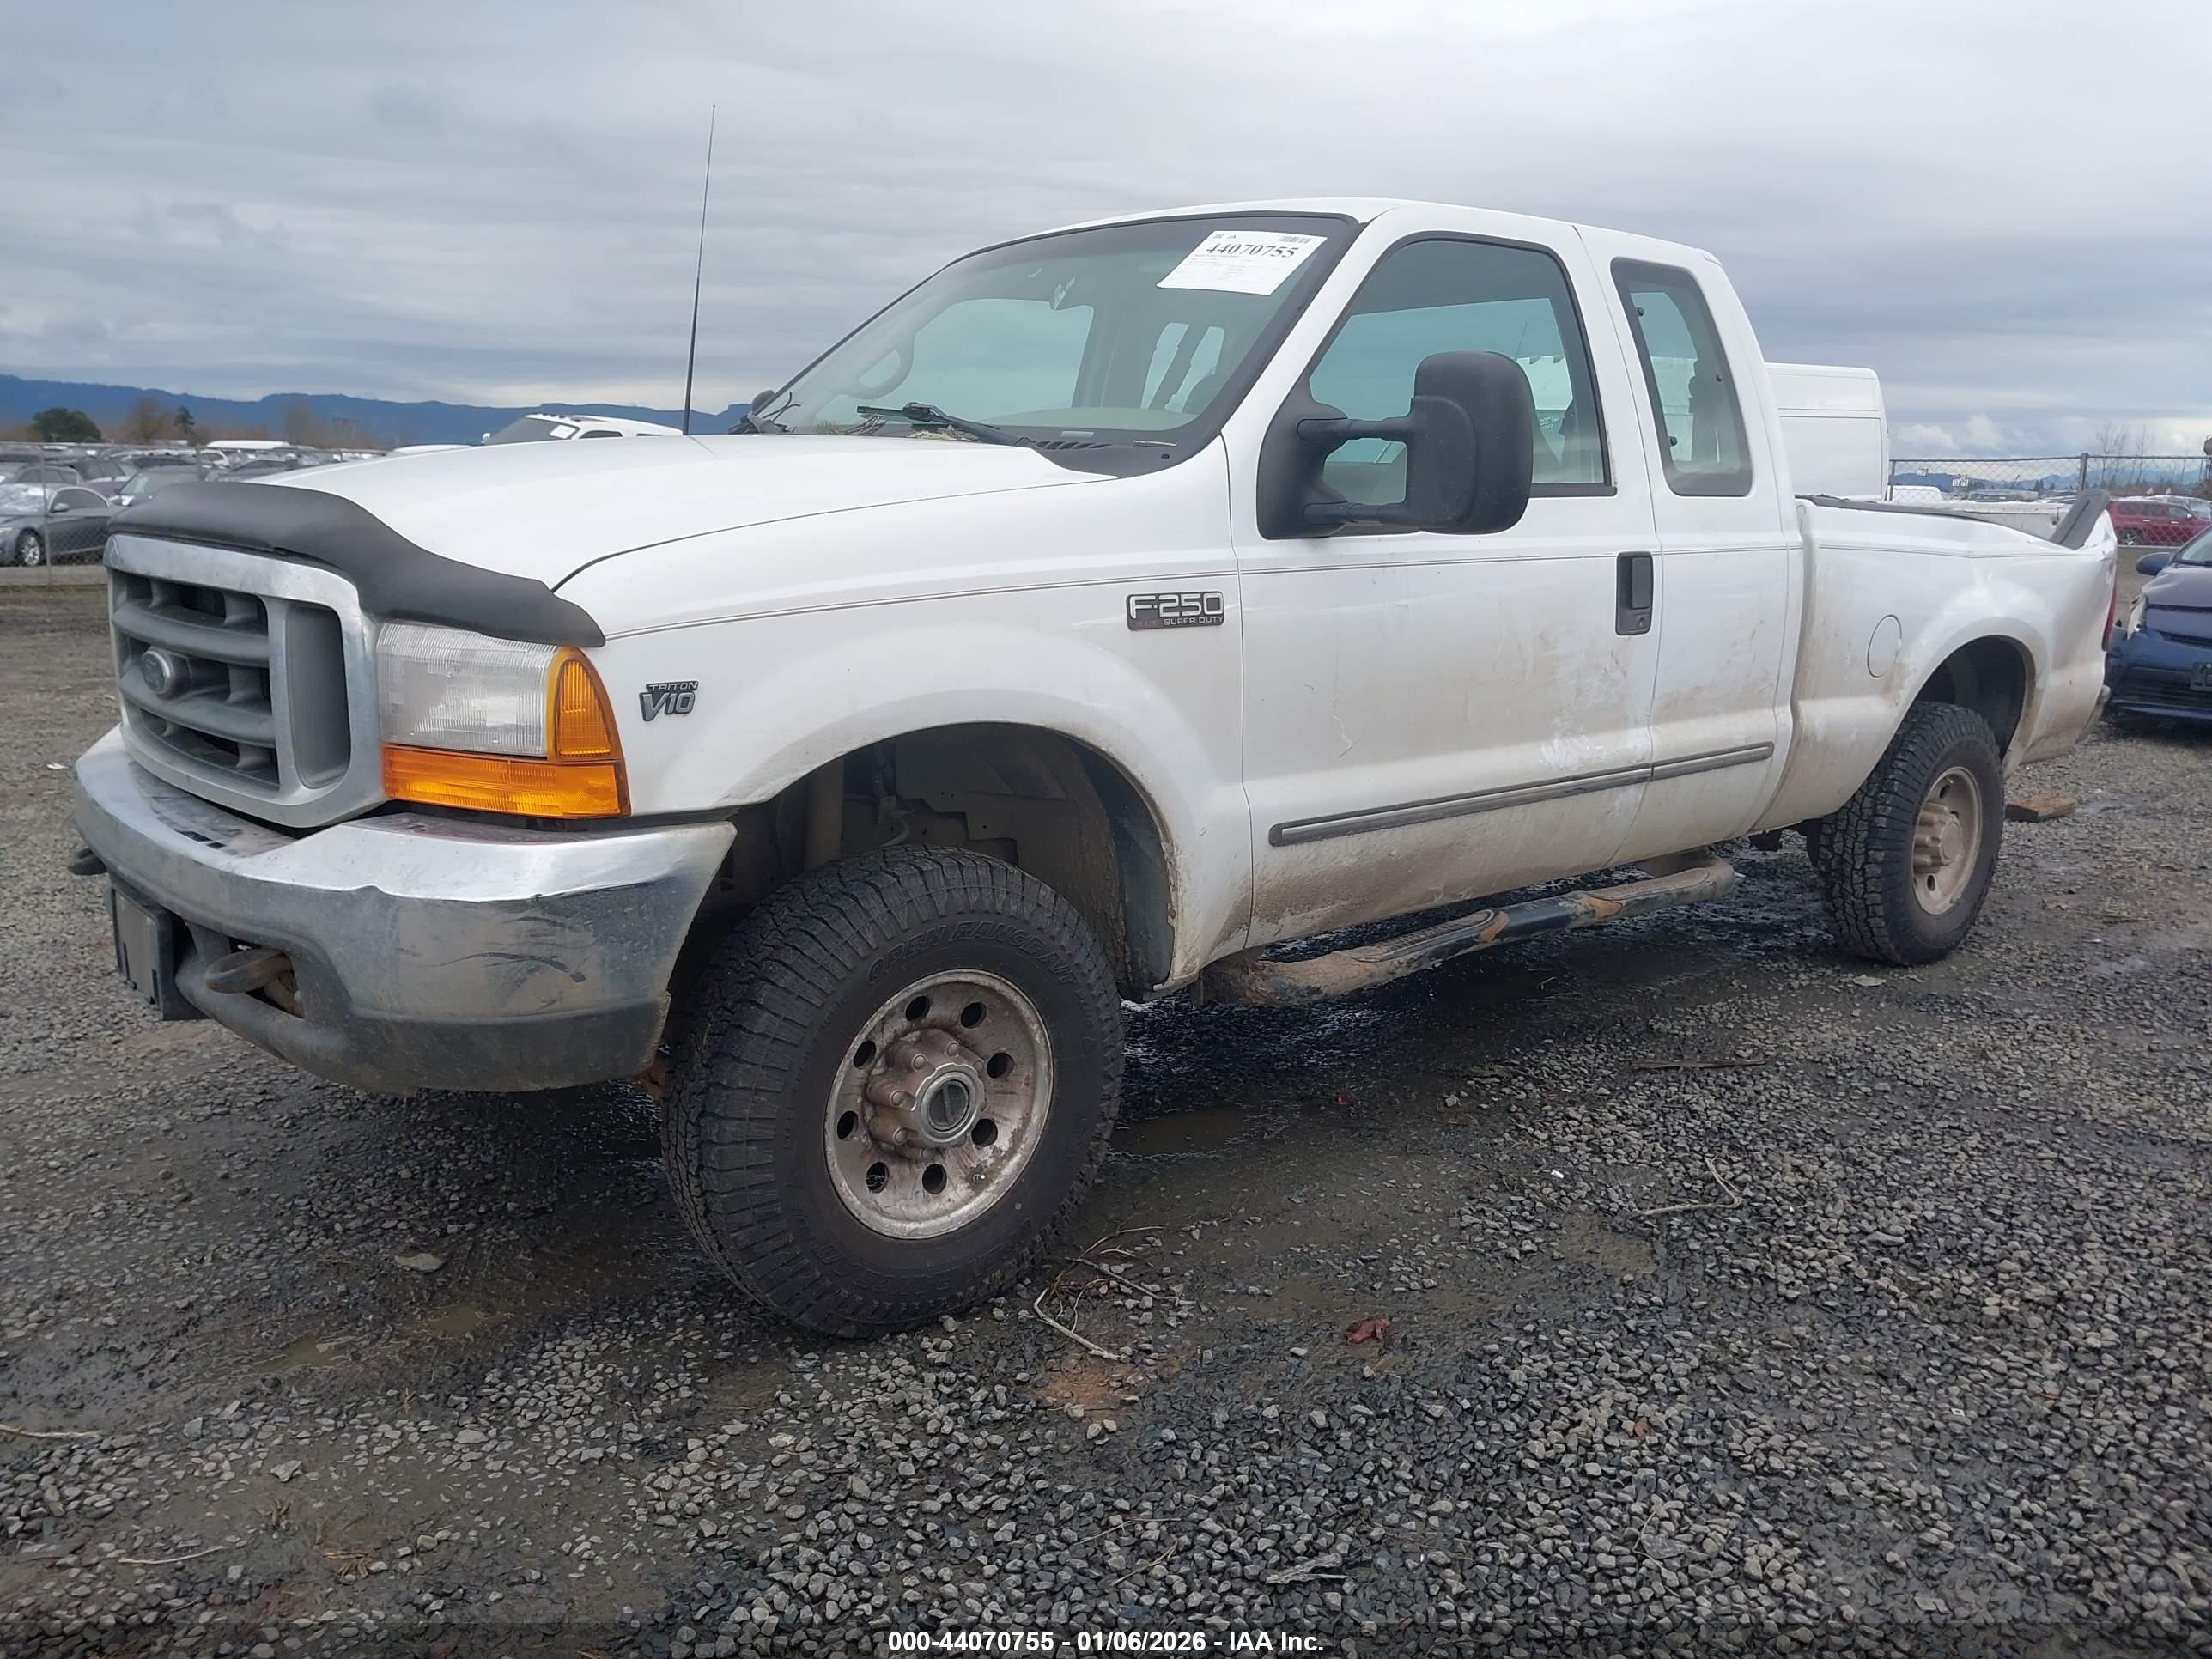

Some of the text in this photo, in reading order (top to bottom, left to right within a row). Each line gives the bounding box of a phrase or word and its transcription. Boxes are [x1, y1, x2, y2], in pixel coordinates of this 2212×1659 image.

[1206, 243, 1299, 258] 44070755
[1129, 592, 1224, 618] F-250
[1164, 617, 1196, 626] SUPER
[1199, 616, 1224, 624] DUTY
[648, 681, 698, 691] TRITON
[641, 692, 695, 720] V10
[867, 924, 947, 984] OPEN
[949, 921, 1045, 954] RANGE
